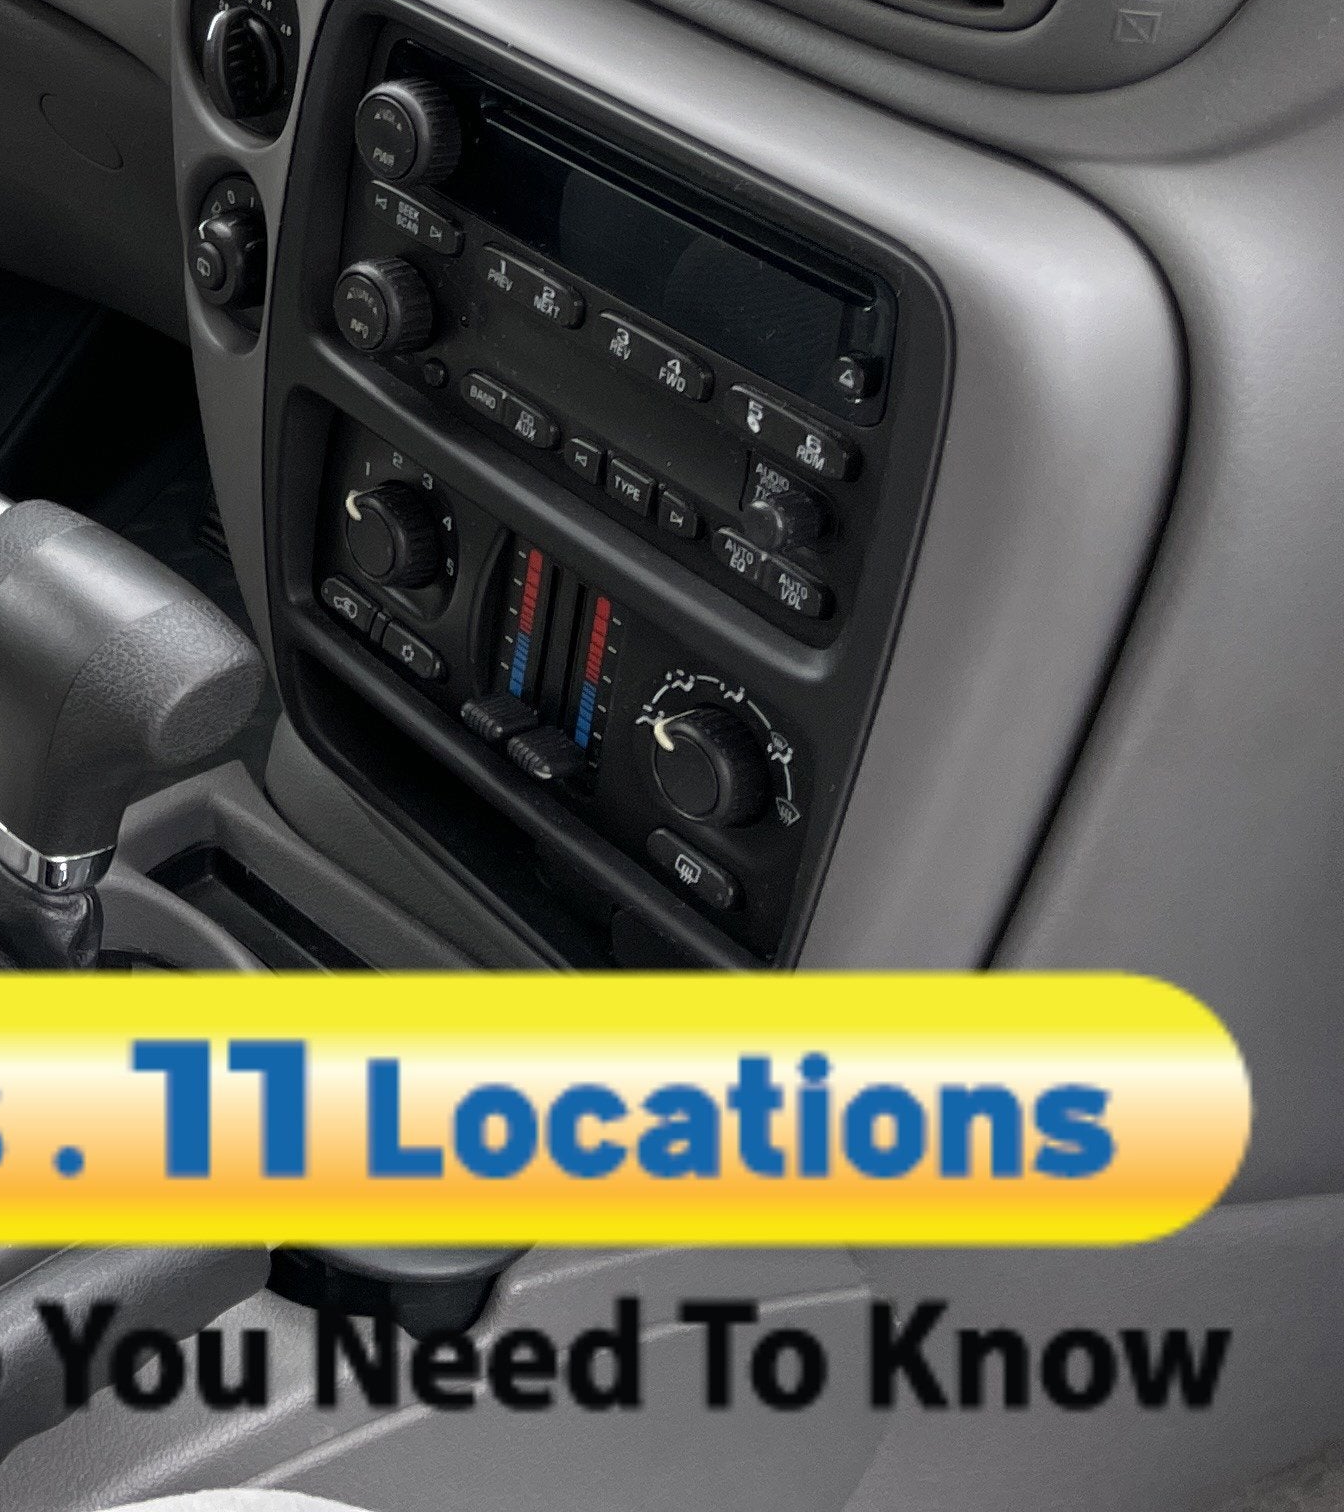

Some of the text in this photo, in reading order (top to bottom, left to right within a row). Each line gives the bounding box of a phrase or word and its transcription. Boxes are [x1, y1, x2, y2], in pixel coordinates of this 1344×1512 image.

[533, 294, 561, 319] NEXT
[616, 327, 630, 346] 3
[609, 338, 632, 361] REV
[666, 358, 681, 375] 4
[658, 366, 687, 393] FWD
[469, 384, 497, 410] BAND
[514, 419, 538, 442] AUX
[365, 461, 371, 476] 1
[392, 451, 404, 470] 2
[795, 444, 826, 472] RDM
[421, 472, 434, 491] 3
[614, 474, 642, 503] TYPE
[442, 515, 453, 532] 4
[724, 538, 755, 566] AUTO
[445, 556, 455, 577] 5
[778, 573, 808, 600] AUTO
[780, 586, 802, 611] VOL
